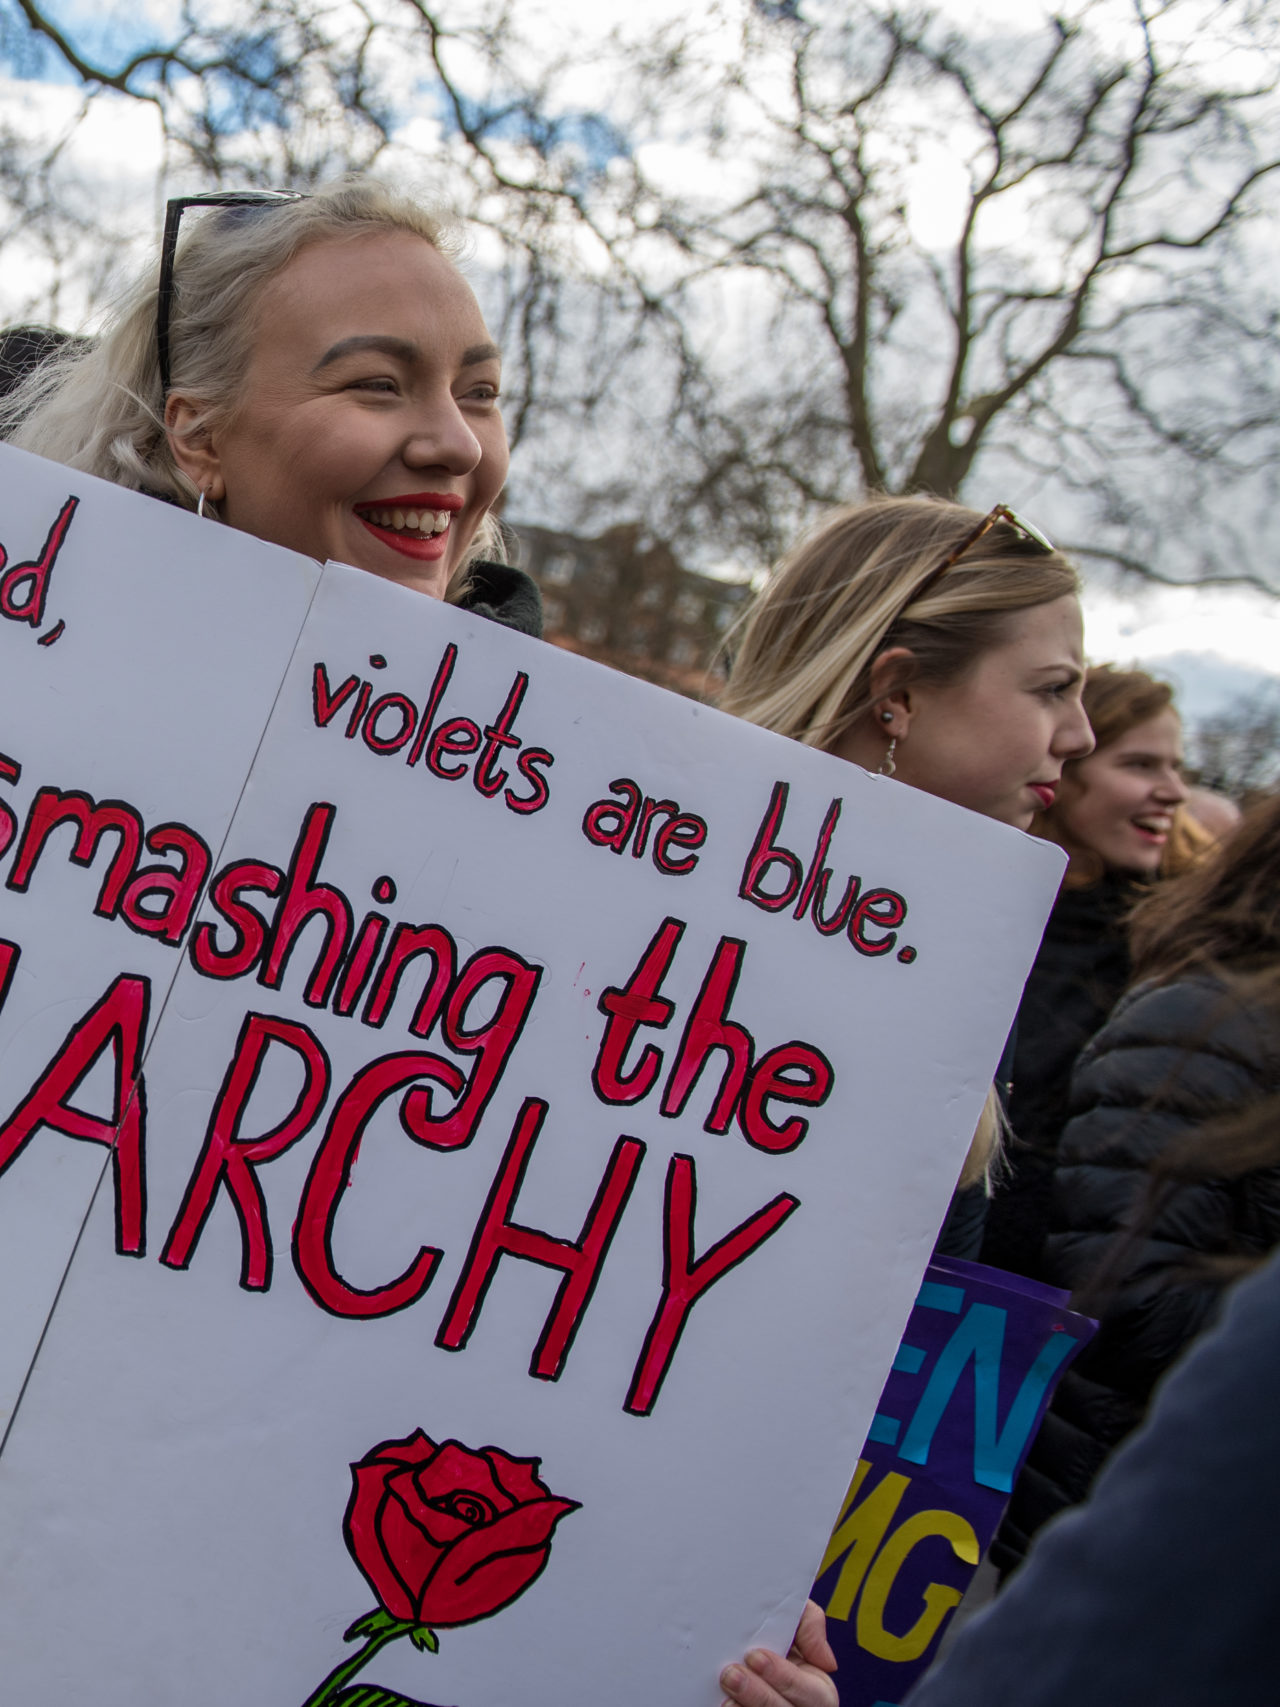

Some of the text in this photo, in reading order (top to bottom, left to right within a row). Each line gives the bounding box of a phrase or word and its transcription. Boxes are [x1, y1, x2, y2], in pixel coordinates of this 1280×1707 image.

[310, 642, 555, 816] violets
[581, 777, 708, 877] are
[737, 780, 918, 965] blue.
[590, 915, 836, 1156] the
